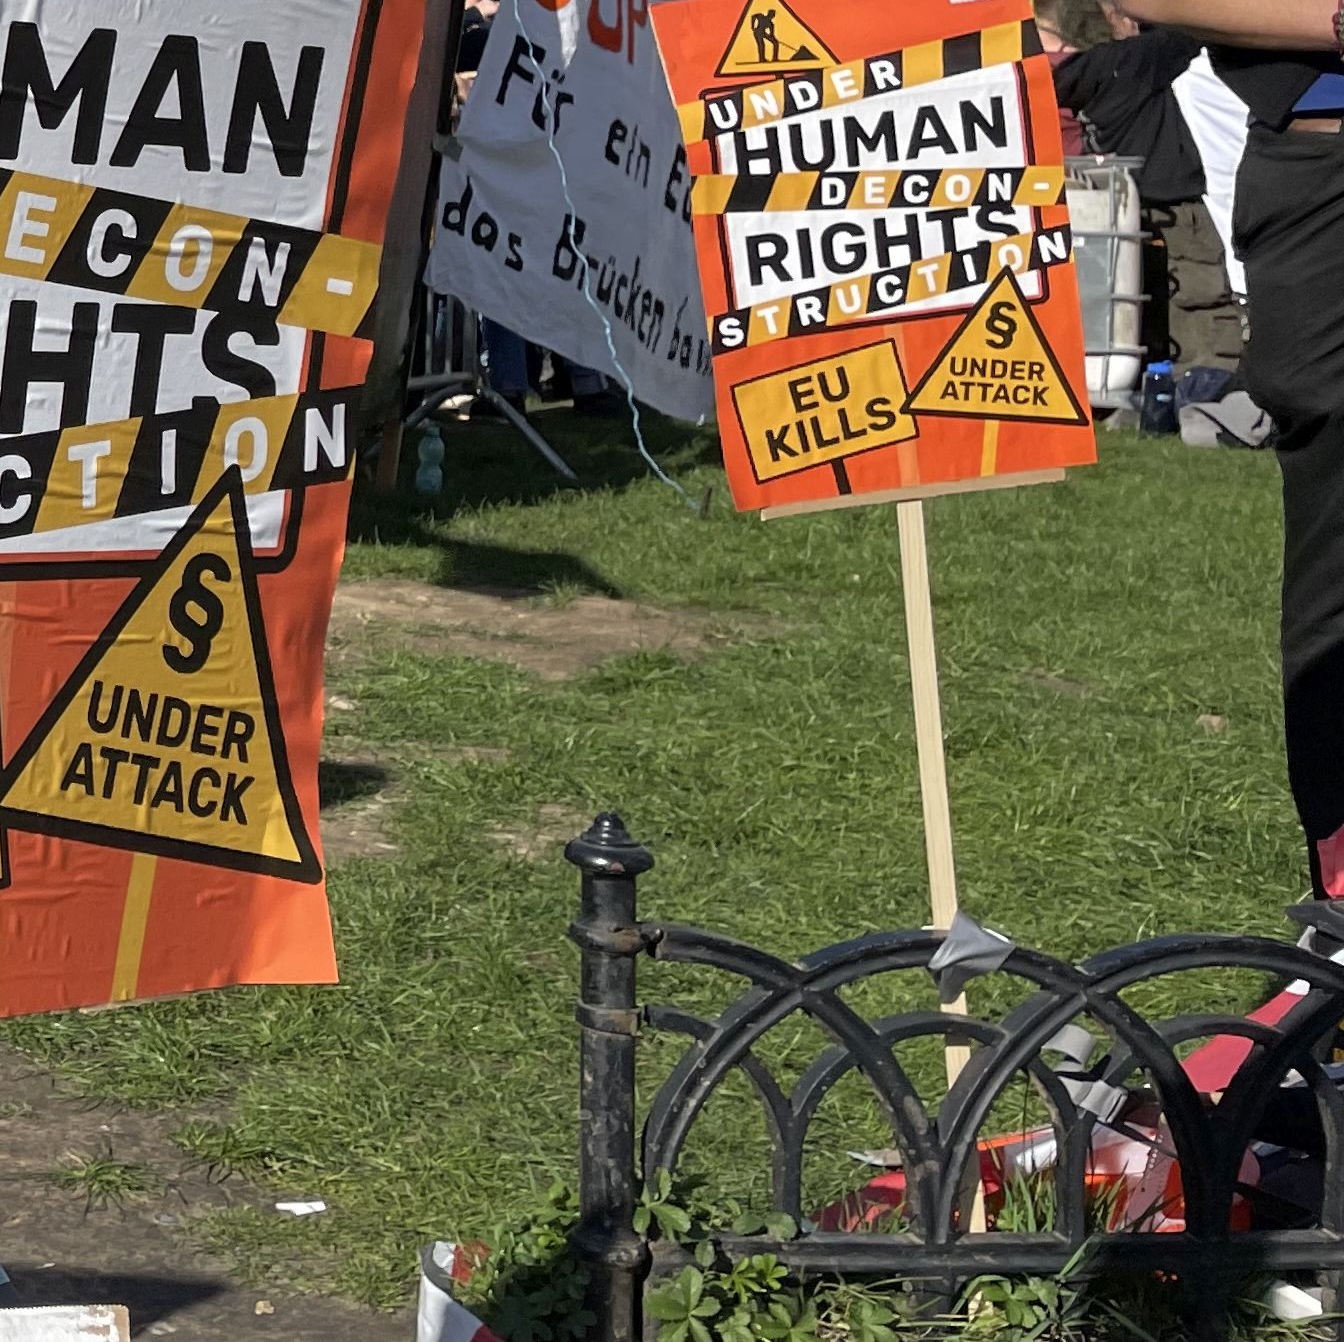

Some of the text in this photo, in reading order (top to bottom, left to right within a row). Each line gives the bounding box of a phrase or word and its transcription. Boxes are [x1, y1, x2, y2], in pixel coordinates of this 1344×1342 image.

[495, 34, 574, 137] Für
[605, 117, 651, 189] ein
[709, 59, 902, 131] UNDER
[736, 95, 1008, 175] HUMAN
[821, 173, 1049, 207] DECON-
[442, 176, 526, 272] das
[552, 213, 665, 355] Brücken
[745, 204, 1020, 288] RIGHTS
[718, 230, 1067, 348] STRUCTION
[789, 366, 850, 413] EU
[940, 381, 1049, 407] ATTACK
[949, 357, 1044, 383] UNDER
[765, 396, 897, 463] KILLS
[88, 680, 255, 765] UNDER
[60, 745, 255, 827] ATTACK
